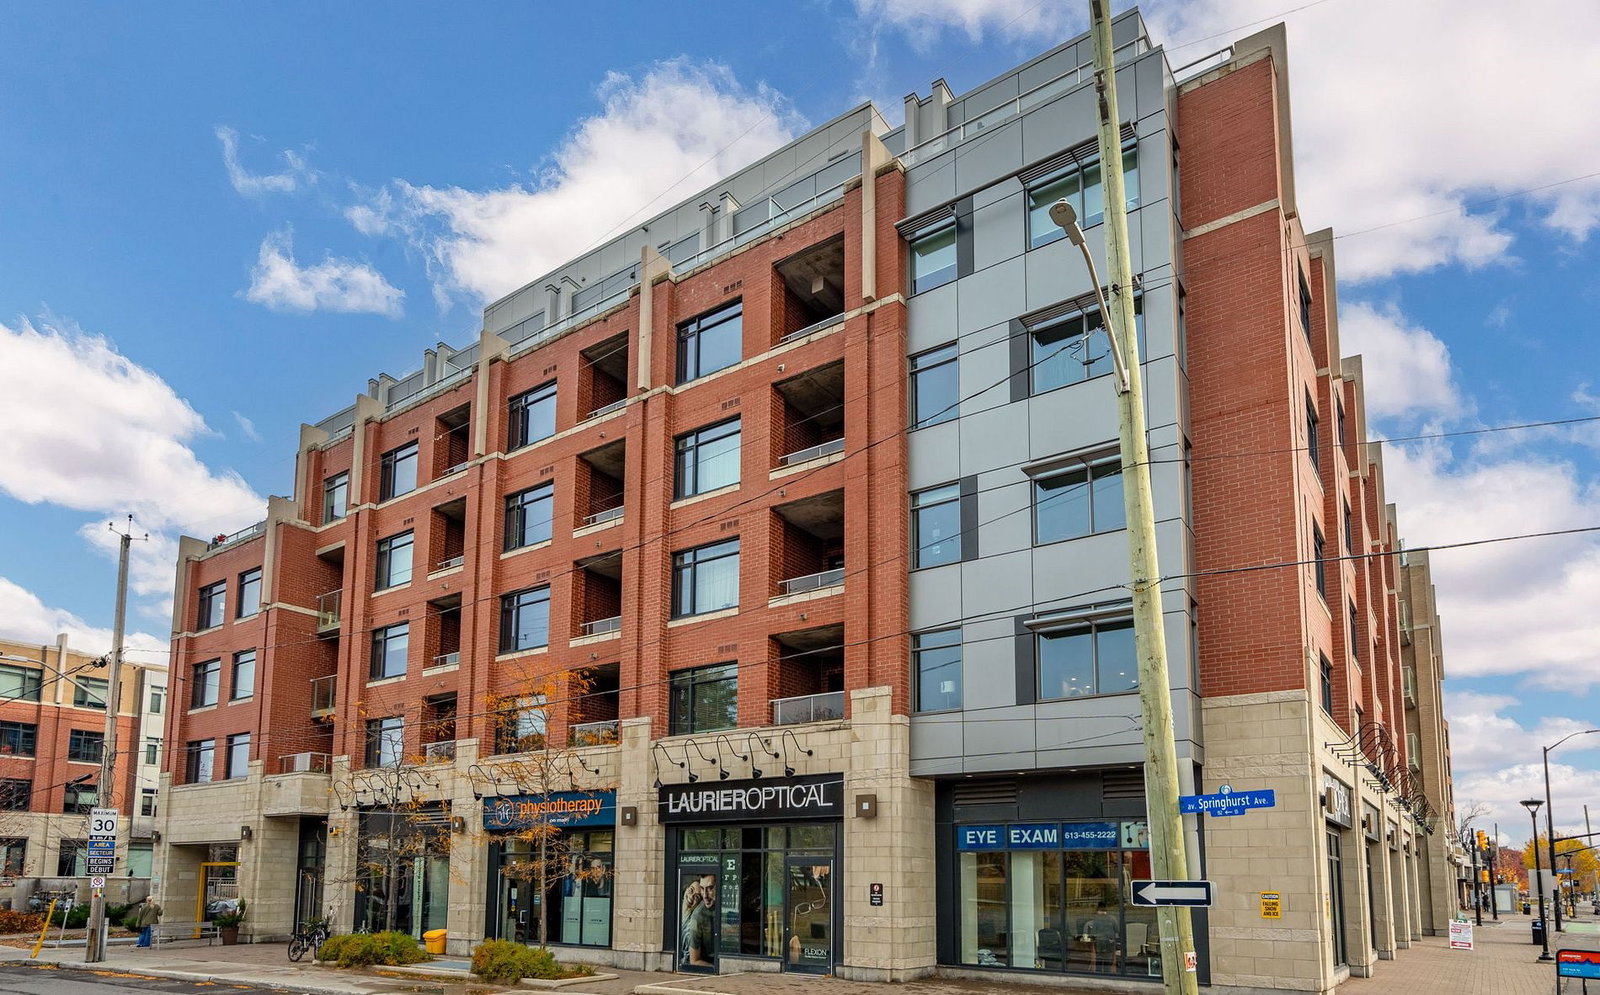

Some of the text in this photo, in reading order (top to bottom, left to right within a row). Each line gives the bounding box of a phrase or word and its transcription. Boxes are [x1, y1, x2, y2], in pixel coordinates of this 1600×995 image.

[520, 797, 603, 818] physiotherapy
[1198, 795, 1250, 811] Springhurst
[93, 819, 115, 832] 30
[966, 829, 1117, 844] EYE EXAM 613-455-2222
[90, 865, 110, 873] DÉBUT
[726, 859, 735, 870] E
